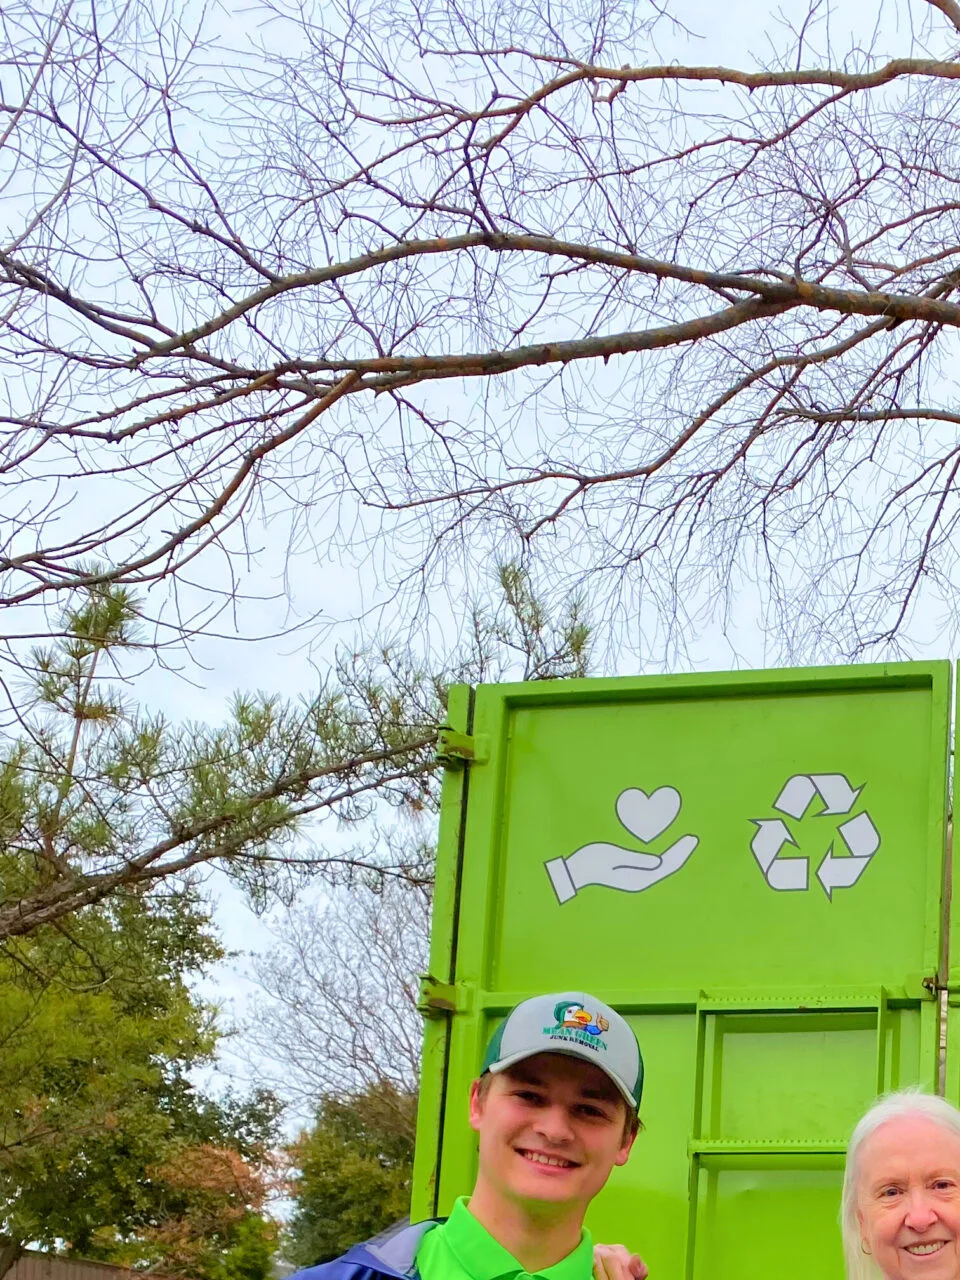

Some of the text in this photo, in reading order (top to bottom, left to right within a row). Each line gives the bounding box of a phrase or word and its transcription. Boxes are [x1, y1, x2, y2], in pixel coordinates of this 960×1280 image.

[542, 1027, 607, 1050] MEAN GREEN
[569, 1036, 599, 1051] REMOVAL
